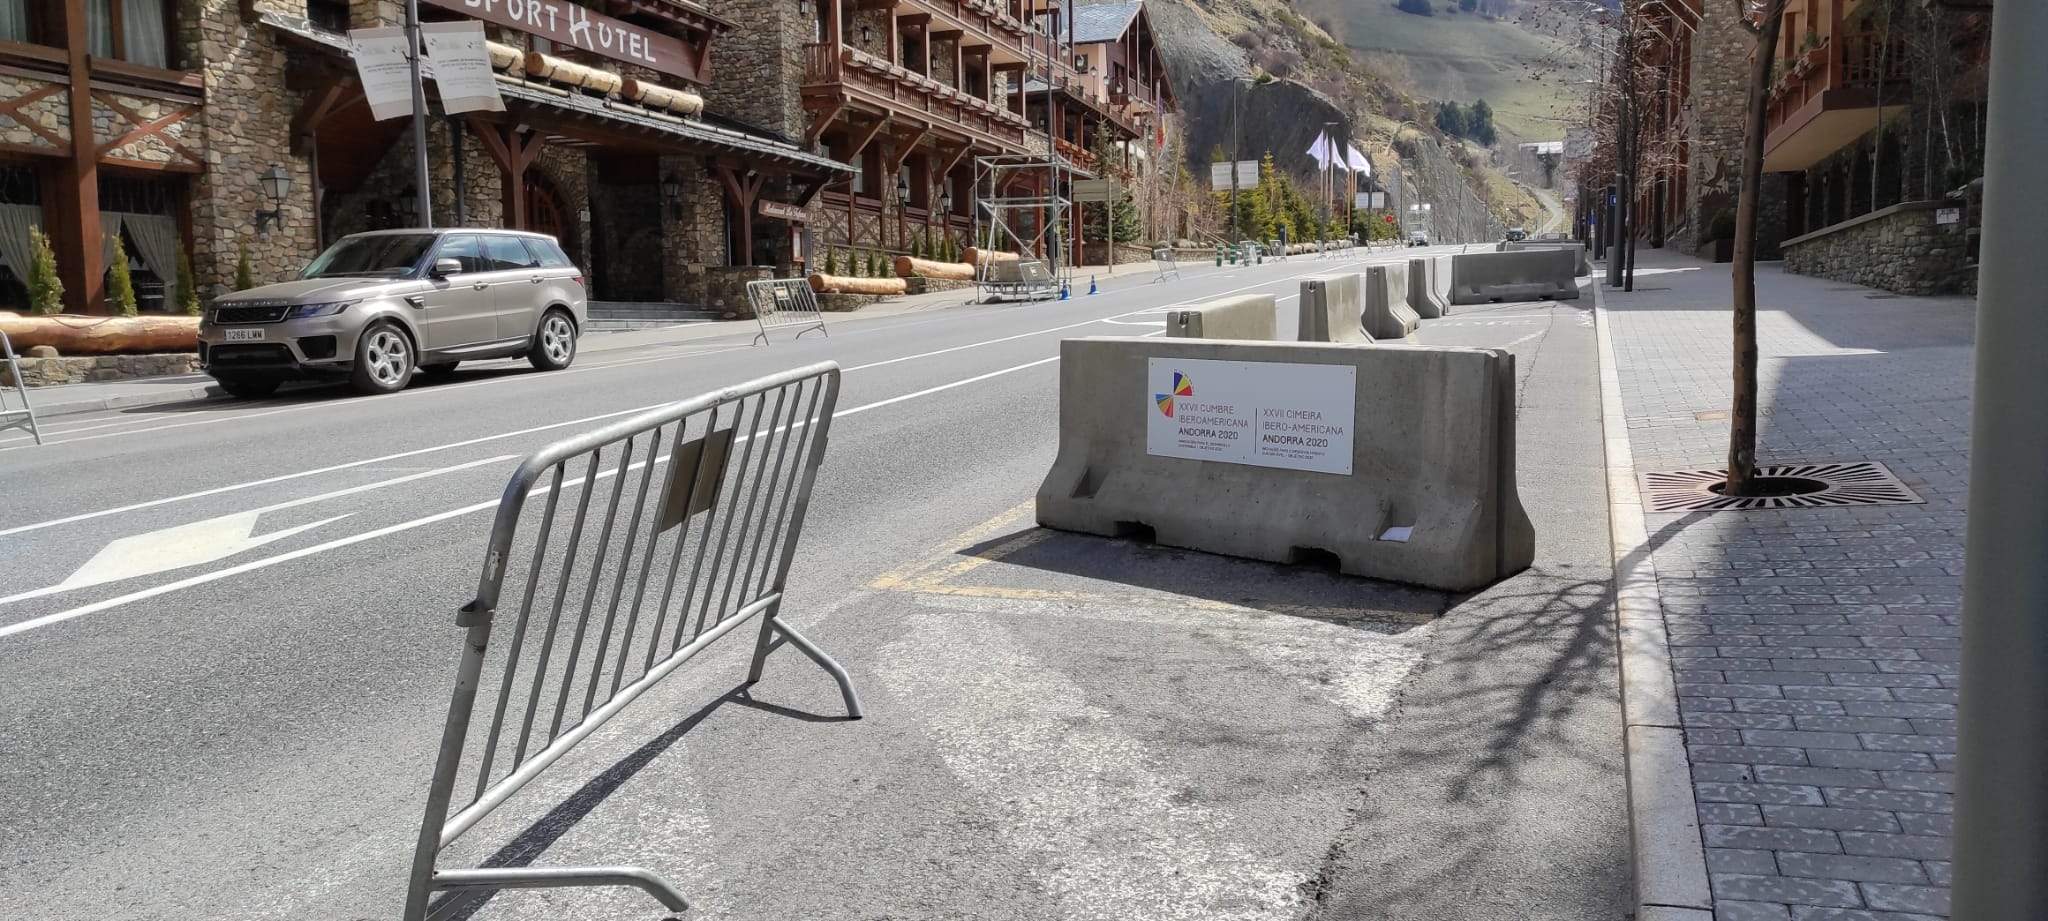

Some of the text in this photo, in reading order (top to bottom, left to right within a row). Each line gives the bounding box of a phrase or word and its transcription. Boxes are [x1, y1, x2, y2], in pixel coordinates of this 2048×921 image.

[569, 2, 657, 63] HOTEL
[1179, 402, 1234, 414] XXVII CUMBRE
[1263, 408, 1322, 420] XXVII CIMEIRA
[1179, 415, 1249, 429] IBEROAMERICANA
[1263, 421, 1344, 436] IBERO-AMERICANA
[1178, 427, 1239, 440] ANDORRA 2020
[1262, 434, 1329, 448] ANDORRA 2020
